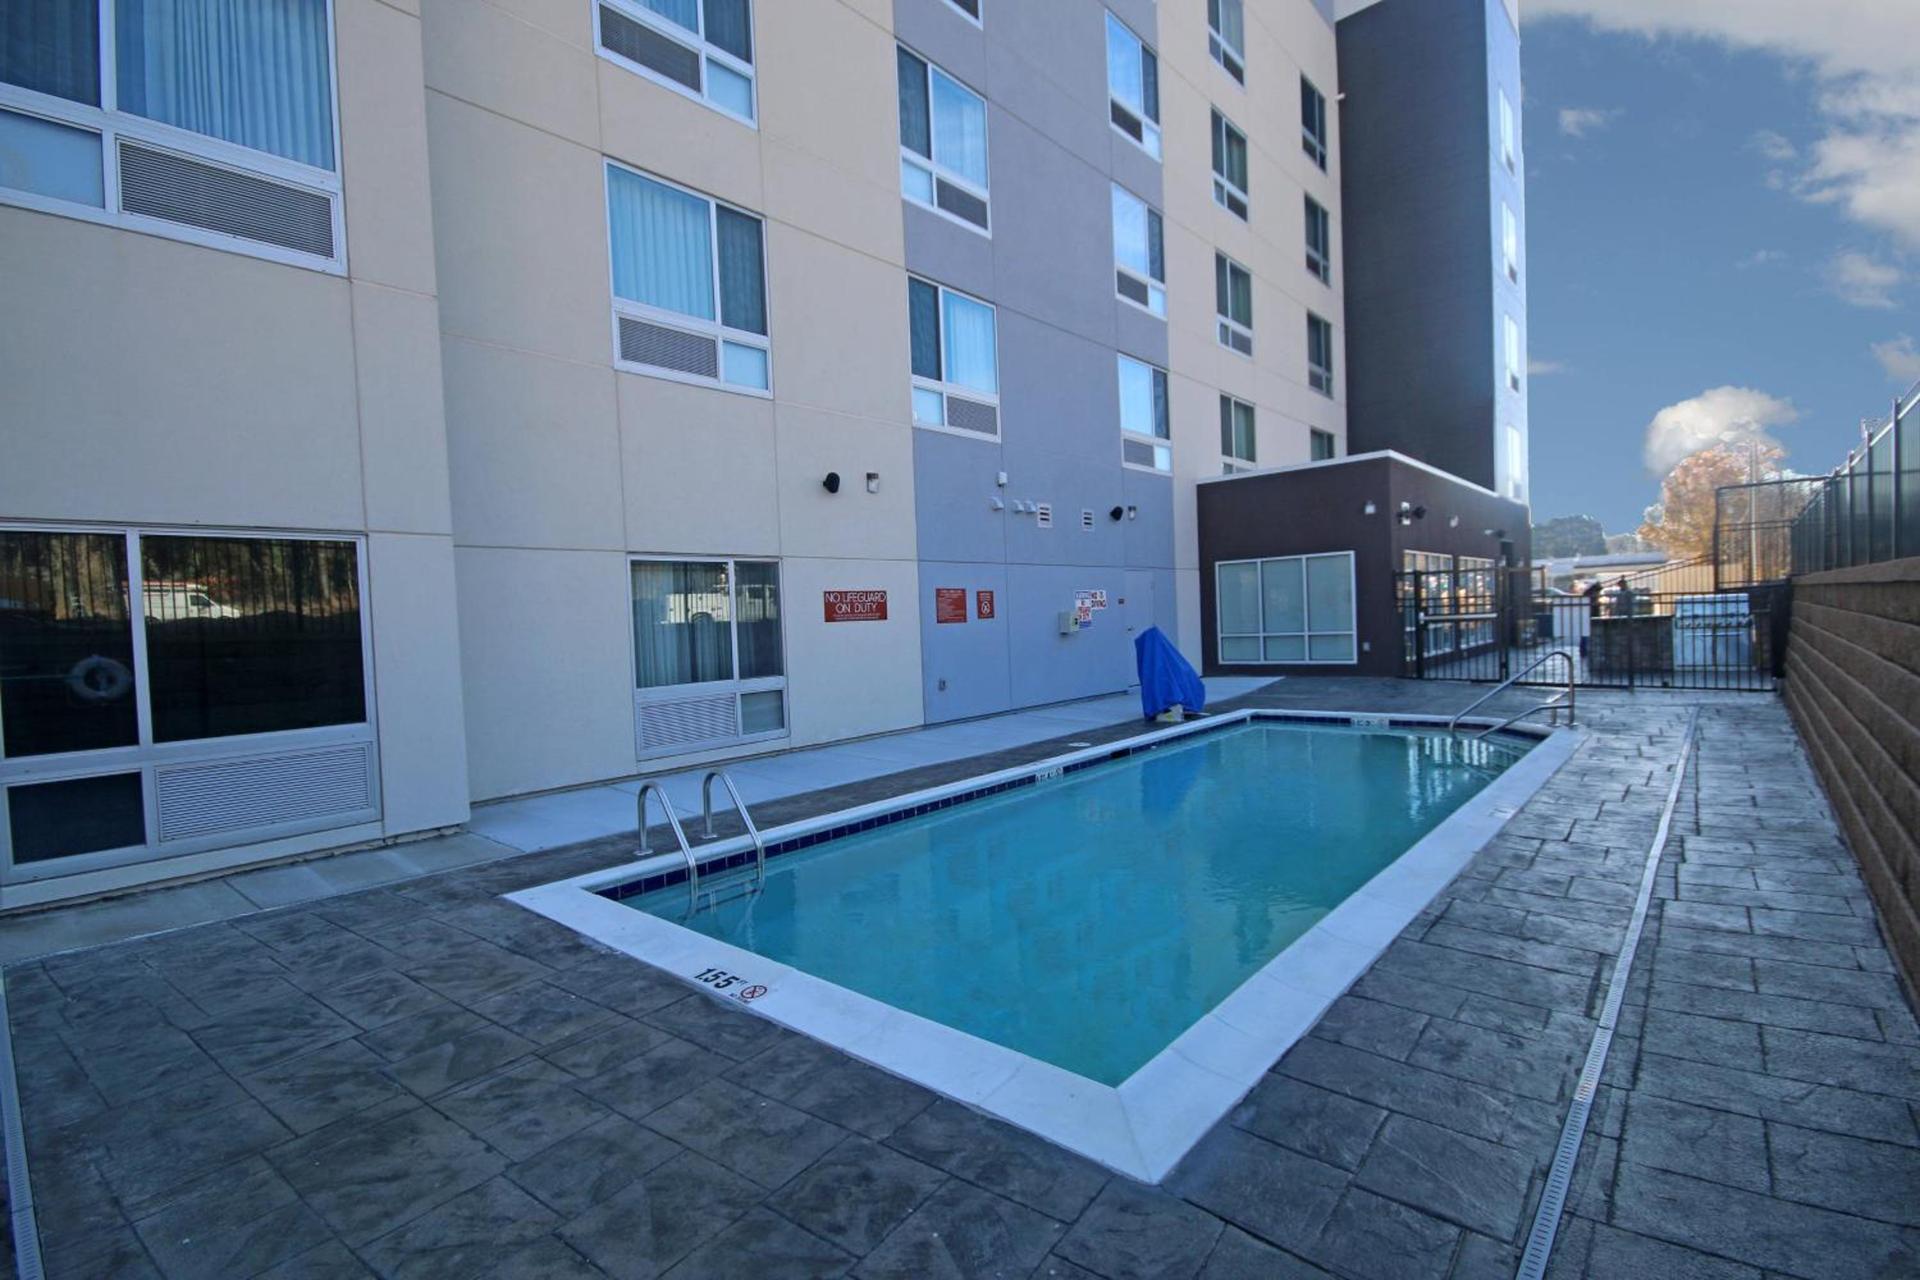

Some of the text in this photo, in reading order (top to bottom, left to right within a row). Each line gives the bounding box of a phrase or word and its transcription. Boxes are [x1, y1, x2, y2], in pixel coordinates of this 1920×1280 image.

[825, 591, 887, 603] NO LIFEGUARD
[835, 602, 878, 614] ON DUTY
